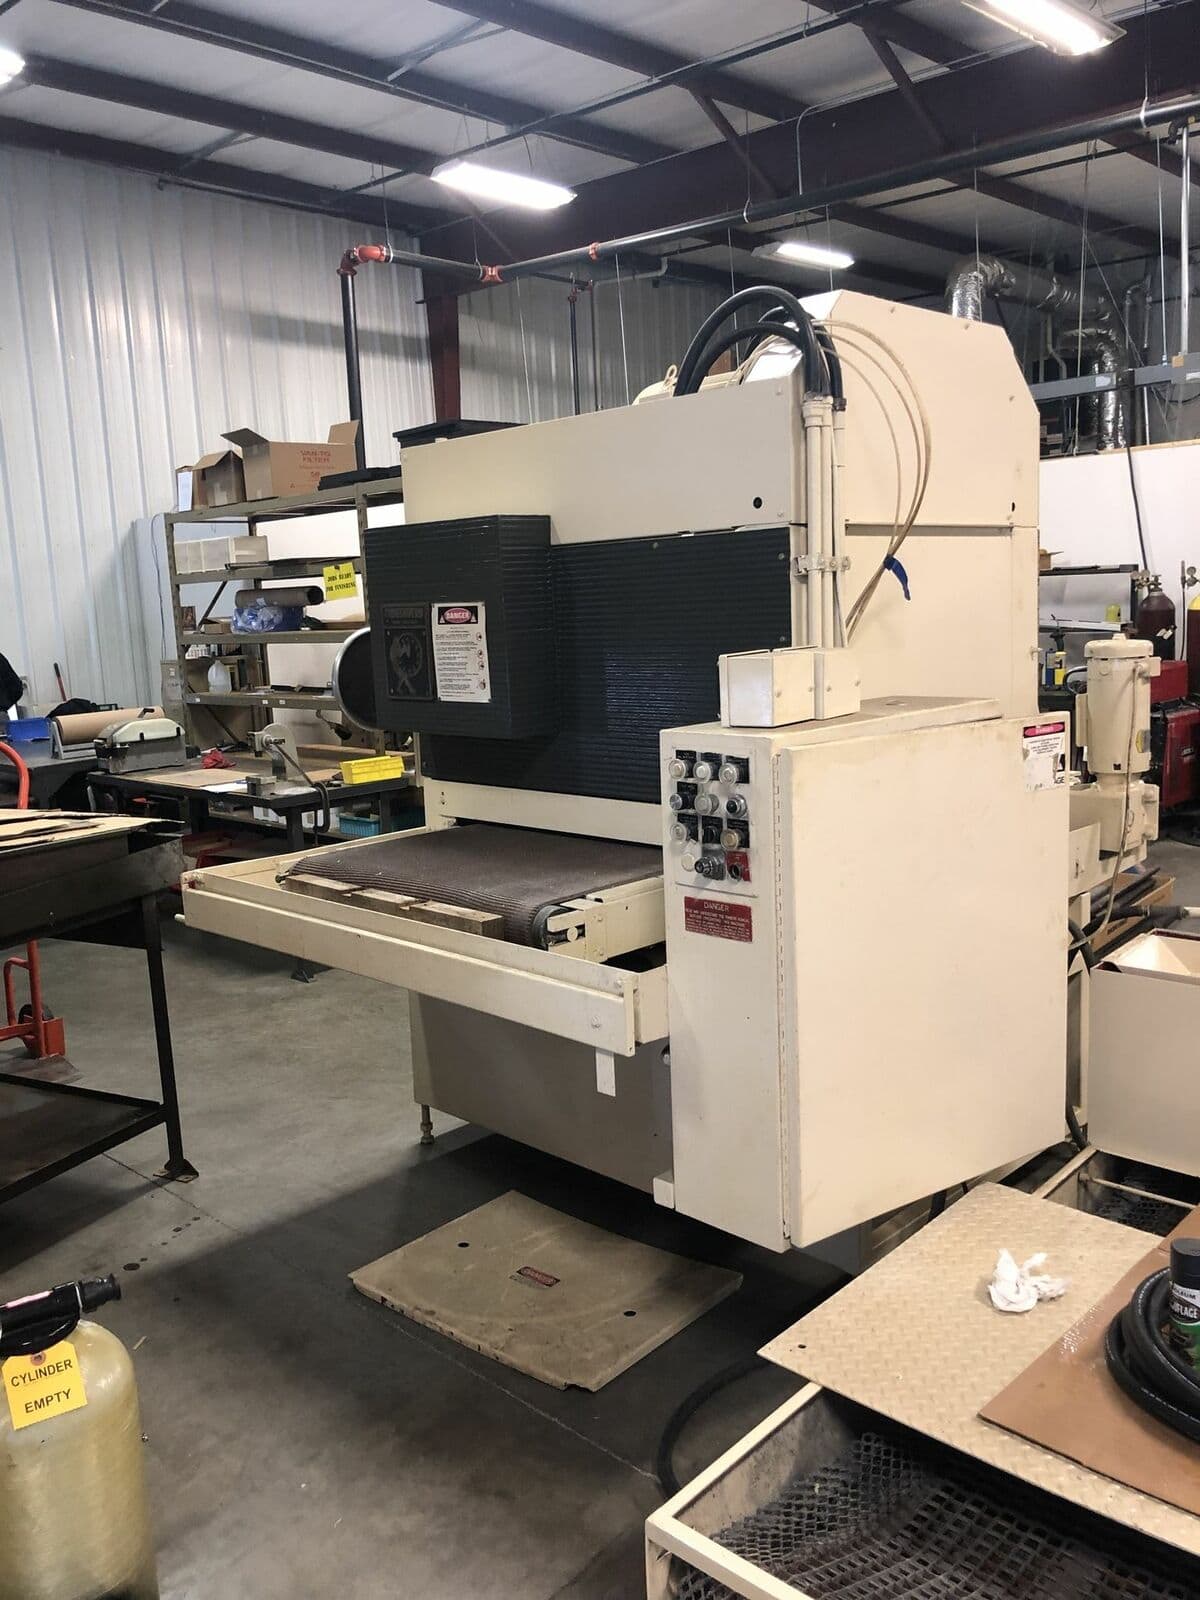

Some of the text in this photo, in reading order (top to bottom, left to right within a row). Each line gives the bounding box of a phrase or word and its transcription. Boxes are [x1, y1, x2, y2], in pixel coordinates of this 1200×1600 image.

[703, 901, 730, 912] DANGER
[11, 1358, 73, 1387] CYLINDER
[24, 1388, 71, 1414] EMPTY
